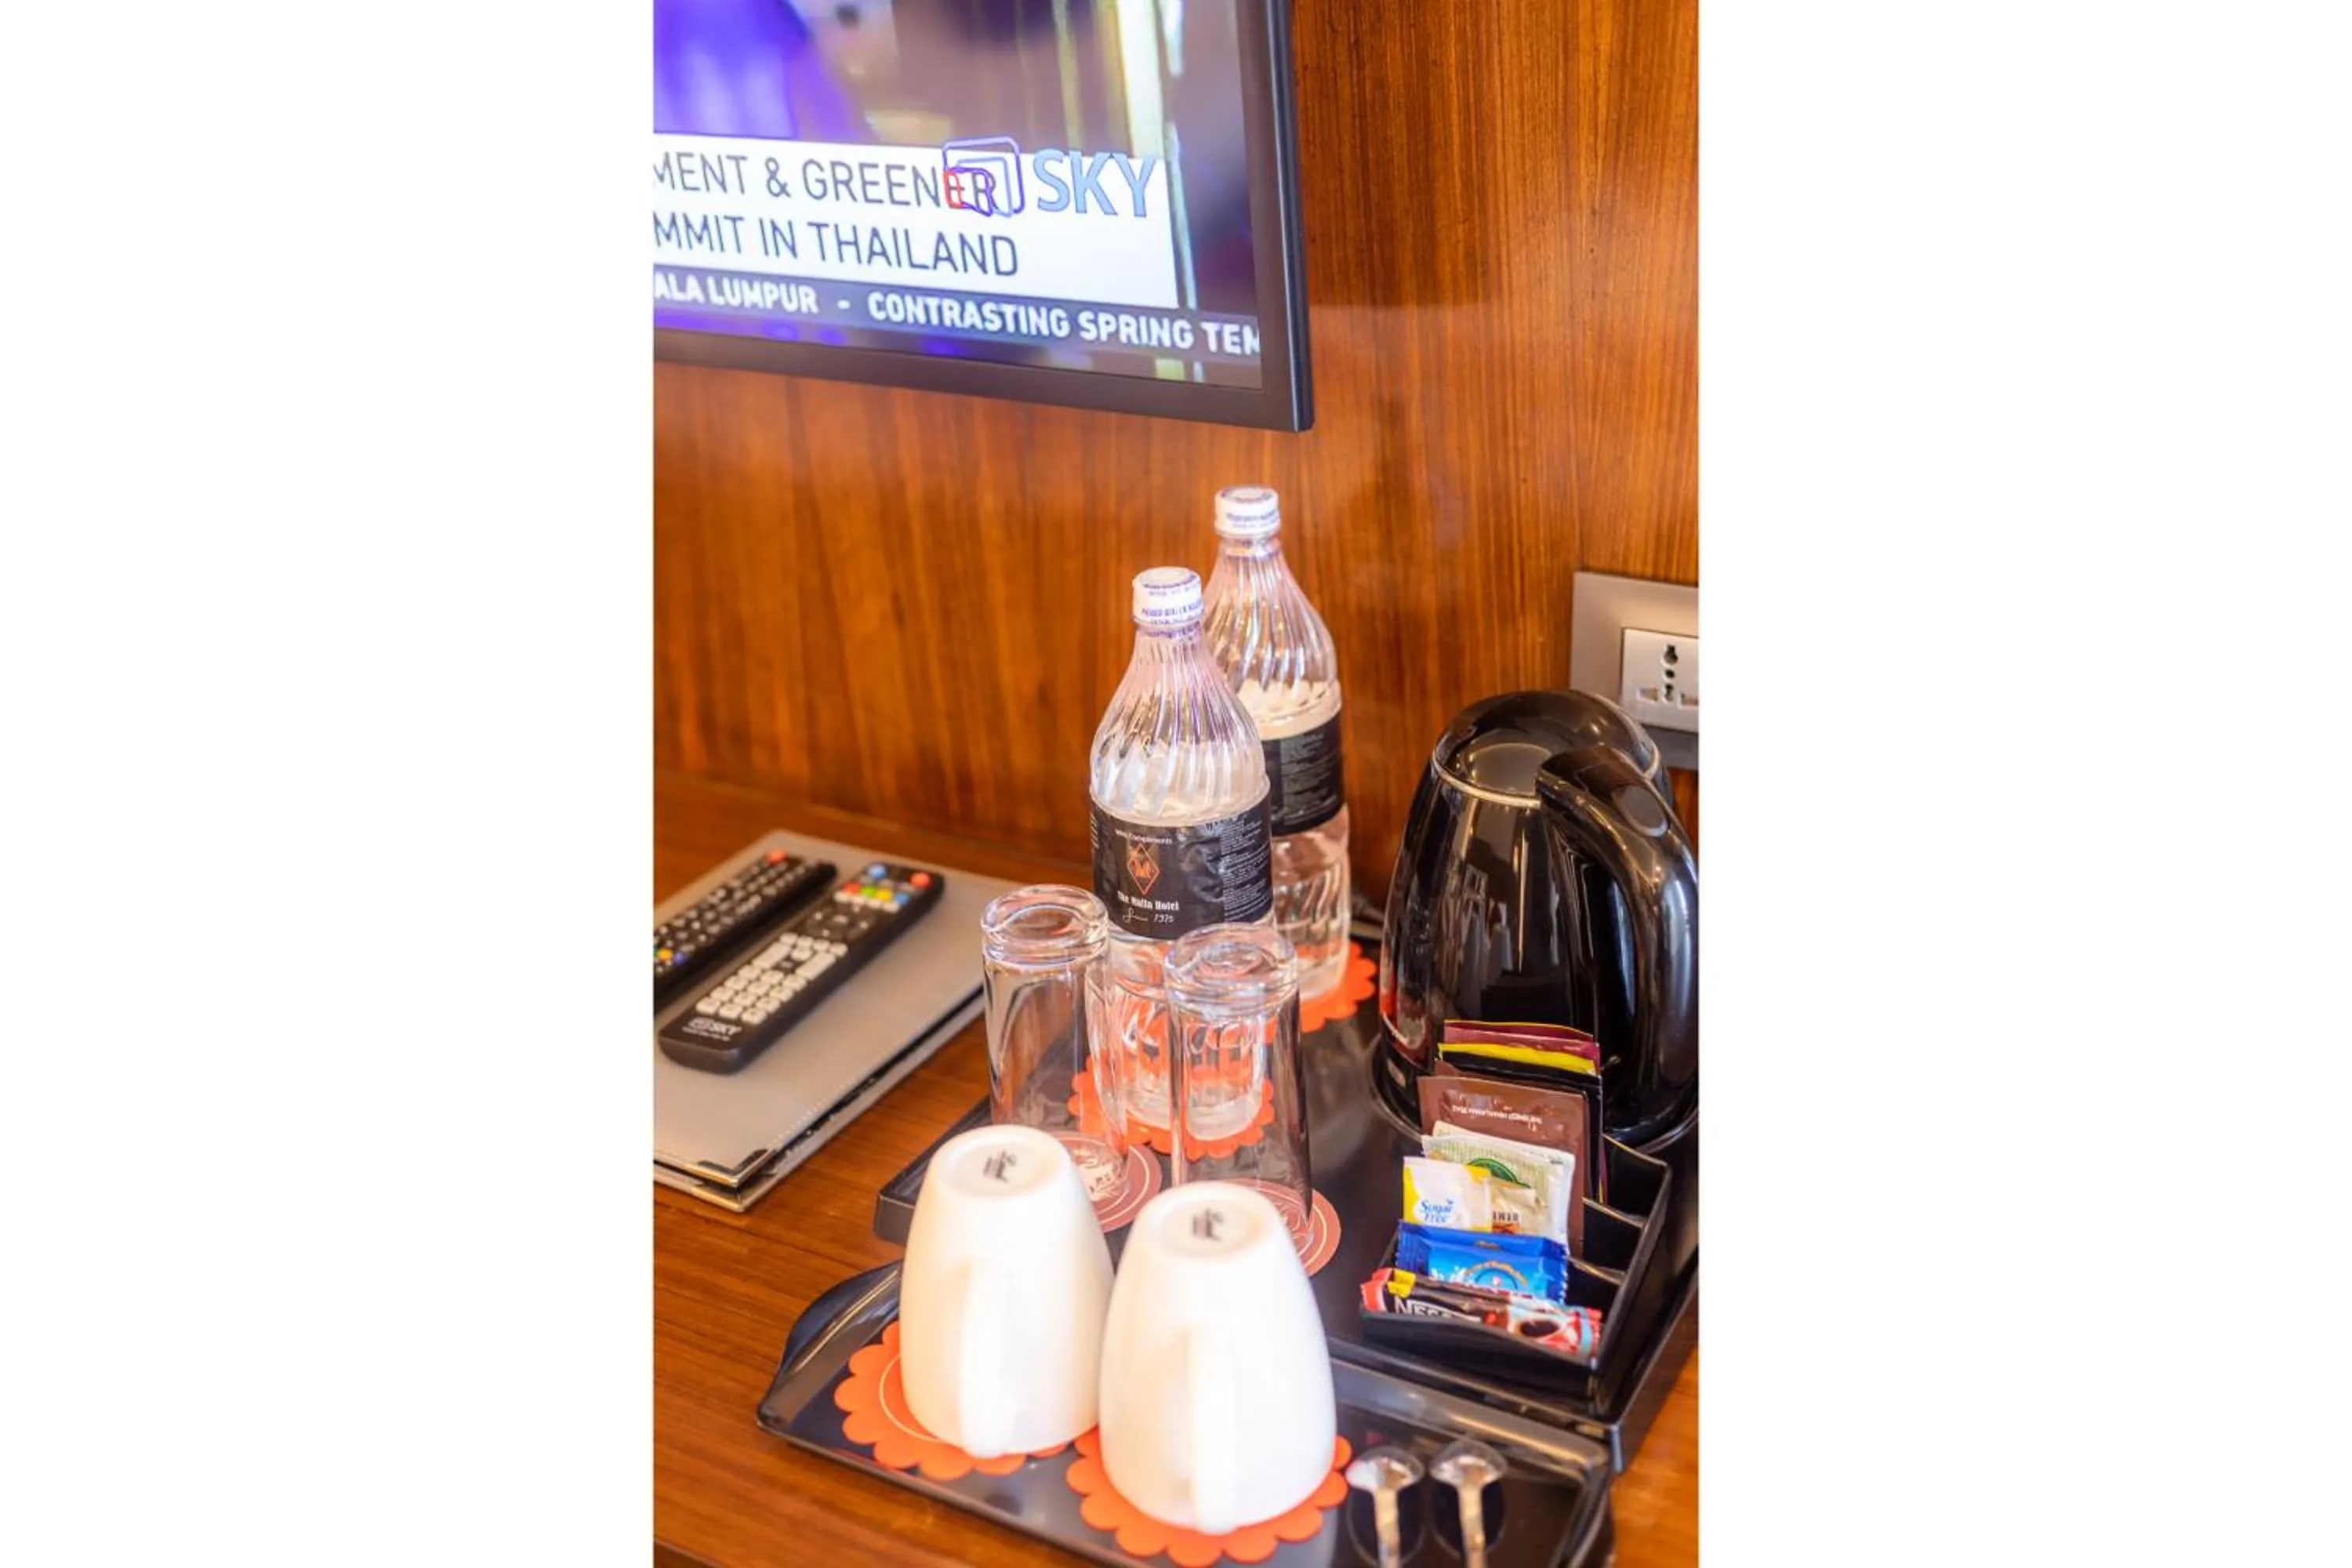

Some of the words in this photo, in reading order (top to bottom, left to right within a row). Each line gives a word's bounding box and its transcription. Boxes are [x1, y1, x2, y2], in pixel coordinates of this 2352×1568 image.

[765, 158, 791, 198] &
[1033, 148, 1157, 218] SKY
[654, 210, 744, 254] MMIT
[759, 217, 798, 260] IN
[808, 222, 1018, 276] THAILAND
[654, 271, 706, 304] ALA
[707, 276, 820, 314] LUMPUR
[868, 291, 1072, 339] CONTRASTING
[1078, 311, 1195, 350] SPRING
[1155, 899, 1179, 910] Hotel
